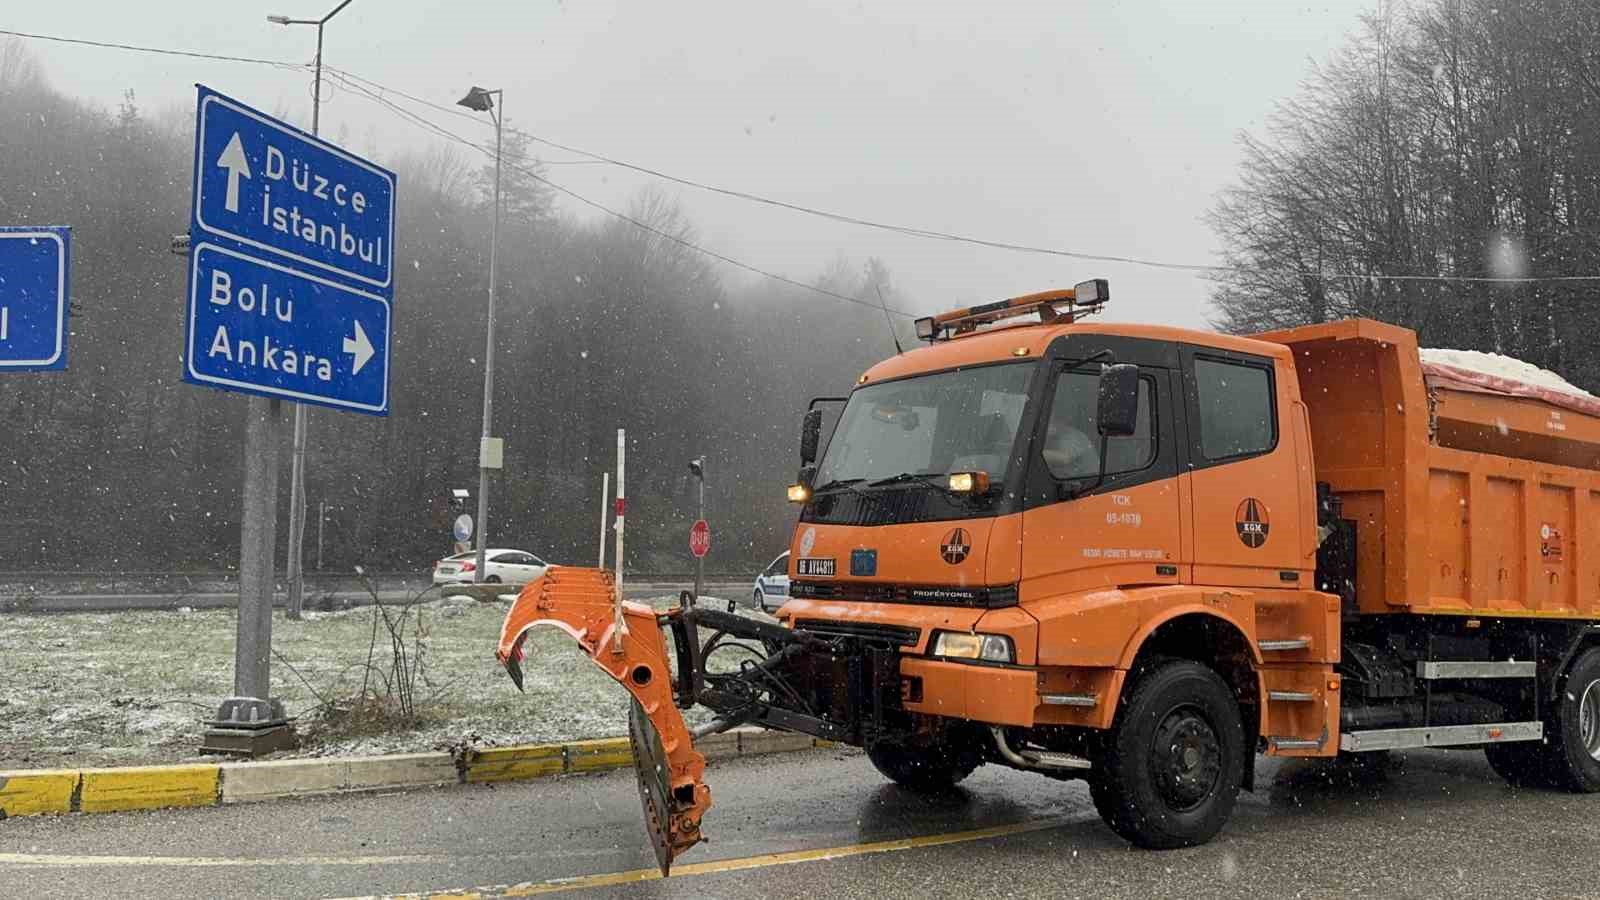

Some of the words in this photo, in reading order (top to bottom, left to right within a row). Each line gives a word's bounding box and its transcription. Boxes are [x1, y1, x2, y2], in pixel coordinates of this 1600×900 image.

[266, 145, 366, 213] Düzce
[263, 184, 382, 266] İstanbul
[210, 269, 293, 322] Bolu
[208, 325, 332, 381] Ankara
[1112, 495, 1131, 505] TCK
[691, 529, 709, 545] DUR
